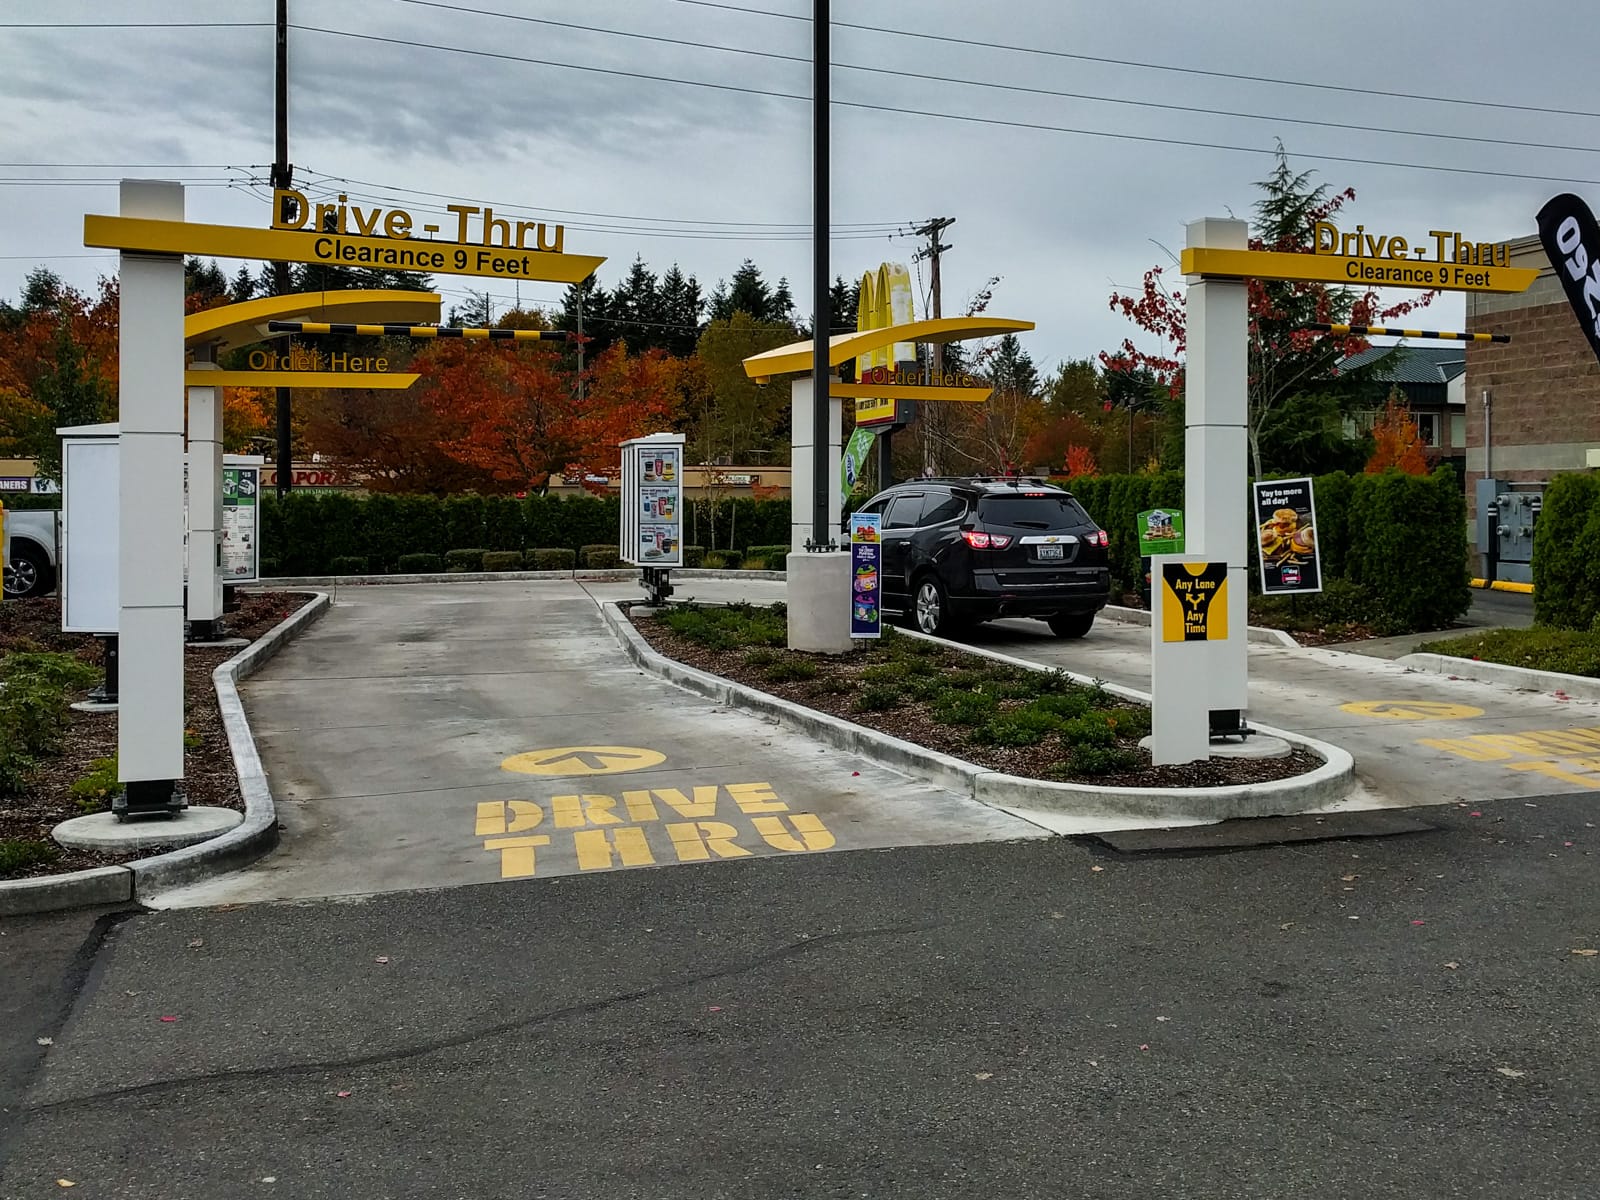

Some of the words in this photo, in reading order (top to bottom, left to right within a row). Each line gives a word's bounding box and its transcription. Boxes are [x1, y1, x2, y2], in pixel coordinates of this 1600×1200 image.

[314, 237, 445, 268] Clearance
[454, 250, 468, 269] 9
[476, 251, 530, 275] Feet
[1346, 260, 1433, 283] Clearance
[1439, 268, 1449, 284] 9
[1455, 268, 1490, 286] Feet
[248, 350, 321, 372] Order
[331, 351, 389, 373] Here
[871, 367, 924, 386] Order
[931, 368, 973, 387] Here
[1260, 489, 1274, 499] Yay
[1283, 487, 1303, 496] more
[1261, 498, 1271, 506] all
[1272, 497, 1289, 506] day!
[1175, 578, 1193, 593] Any
[1195, 577, 1216, 589] Lane
[1187, 610, 1204, 624] Any
[1185, 622, 1206, 633] Time
[475, 782, 791, 836] DRIVE
[483, 813, 837, 879] THRU
